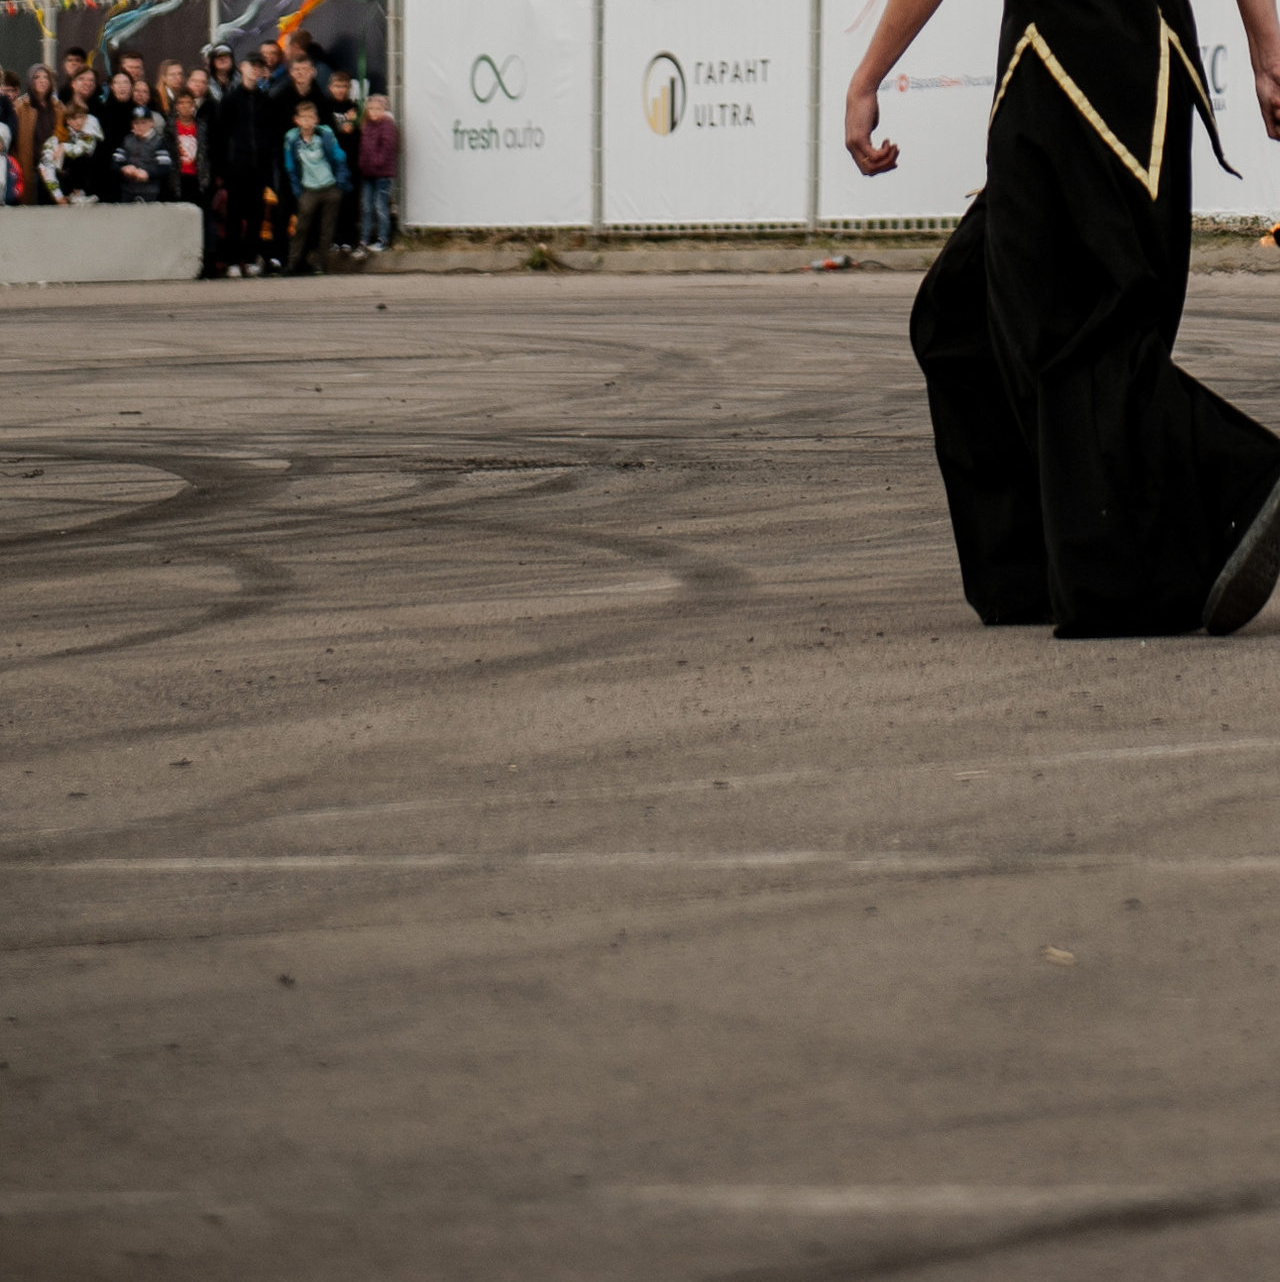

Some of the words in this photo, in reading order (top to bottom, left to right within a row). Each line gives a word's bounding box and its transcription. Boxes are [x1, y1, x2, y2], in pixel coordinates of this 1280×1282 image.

[695, 58, 770, 85] ГАРАНТ
[694, 102, 756, 127] ULTRA
[452, 119, 500, 150] fresh
[503, 119, 546, 149] auto
